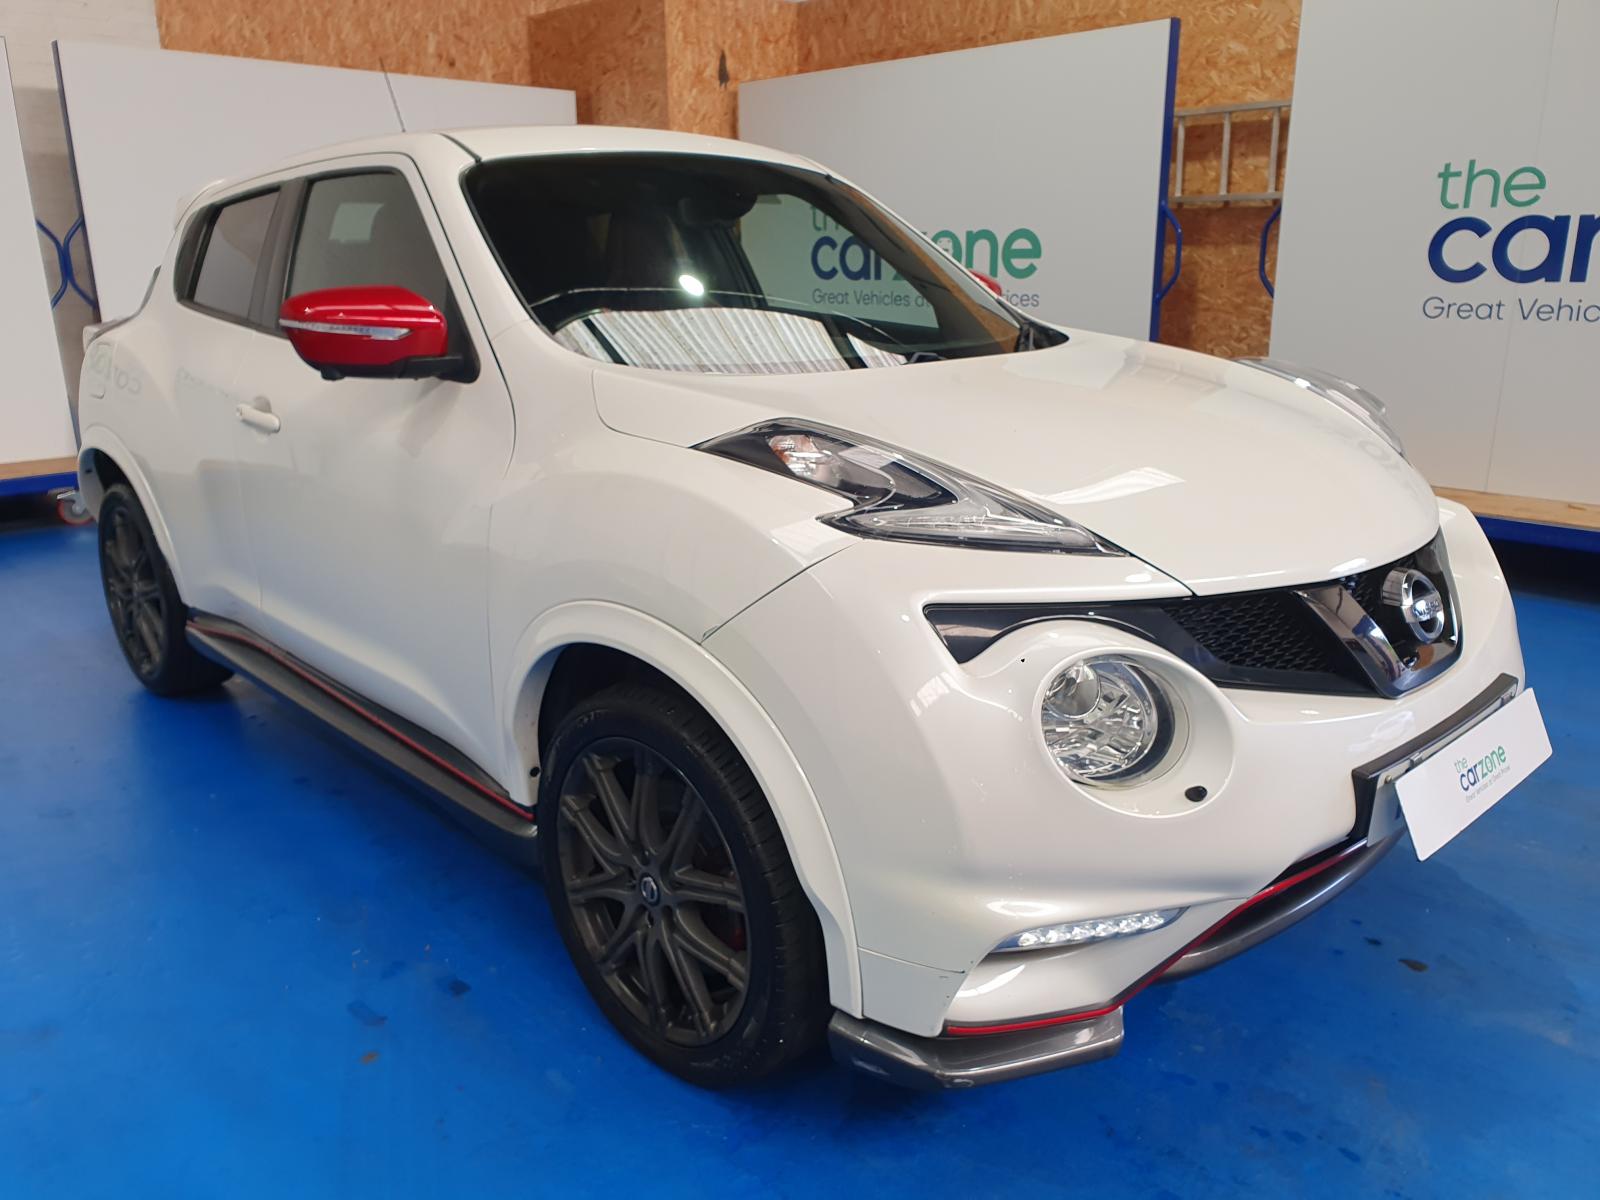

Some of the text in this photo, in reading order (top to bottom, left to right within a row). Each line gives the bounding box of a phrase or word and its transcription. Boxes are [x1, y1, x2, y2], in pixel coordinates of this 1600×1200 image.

[1438, 159, 1547, 209] the
[811, 228, 1042, 281] caone
[1428, 214, 1600, 283] car
[812, 288, 849, 305] Great
[853, 290, 911, 307] Vehicles
[1003, 289, 1040, 308] ices
[1422, 296, 1600, 323] Great Vehic
[1454, 756, 1468, 773] the
[1459, 744, 1507, 792] carzone
